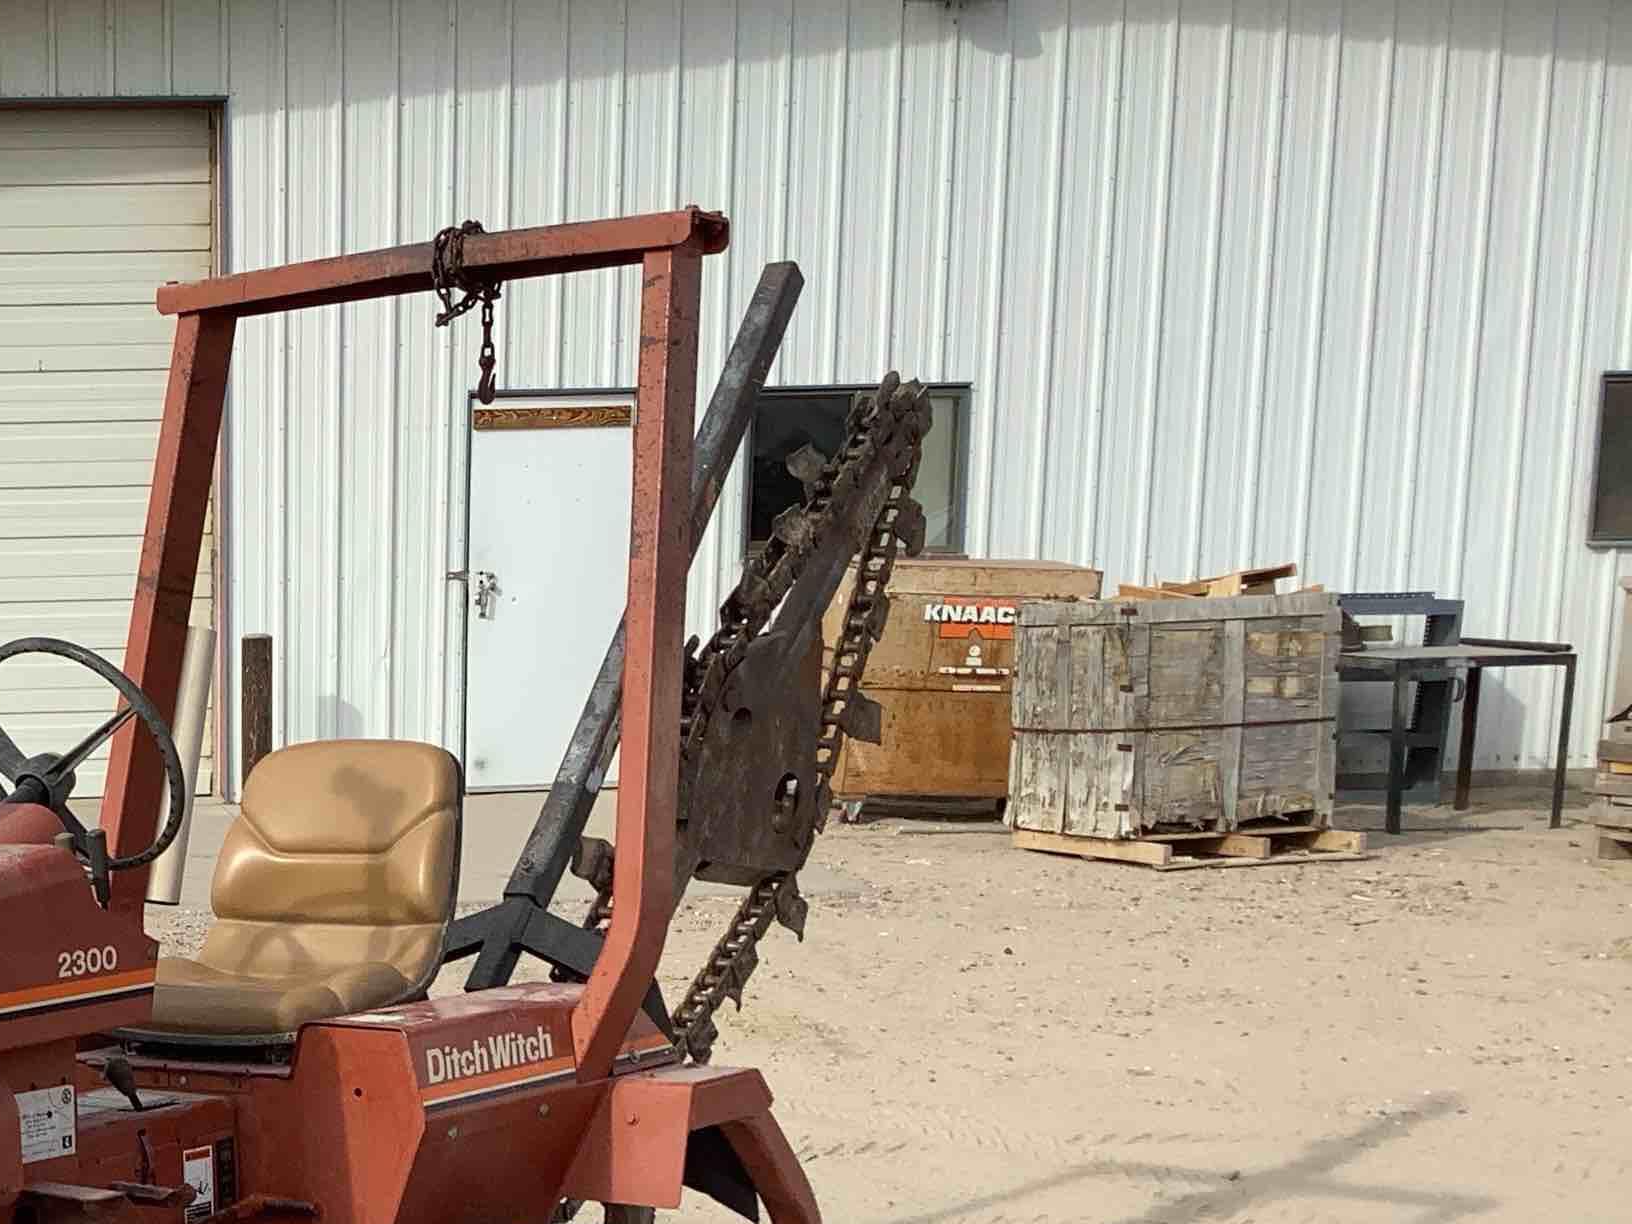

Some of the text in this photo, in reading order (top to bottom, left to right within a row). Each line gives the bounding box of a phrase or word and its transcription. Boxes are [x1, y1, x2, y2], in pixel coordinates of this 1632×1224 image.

[924, 604, 1018, 623] KNAAC
[58, 945, 117, 977] 2300
[426, 1025, 553, 1084] Ditch Witch
